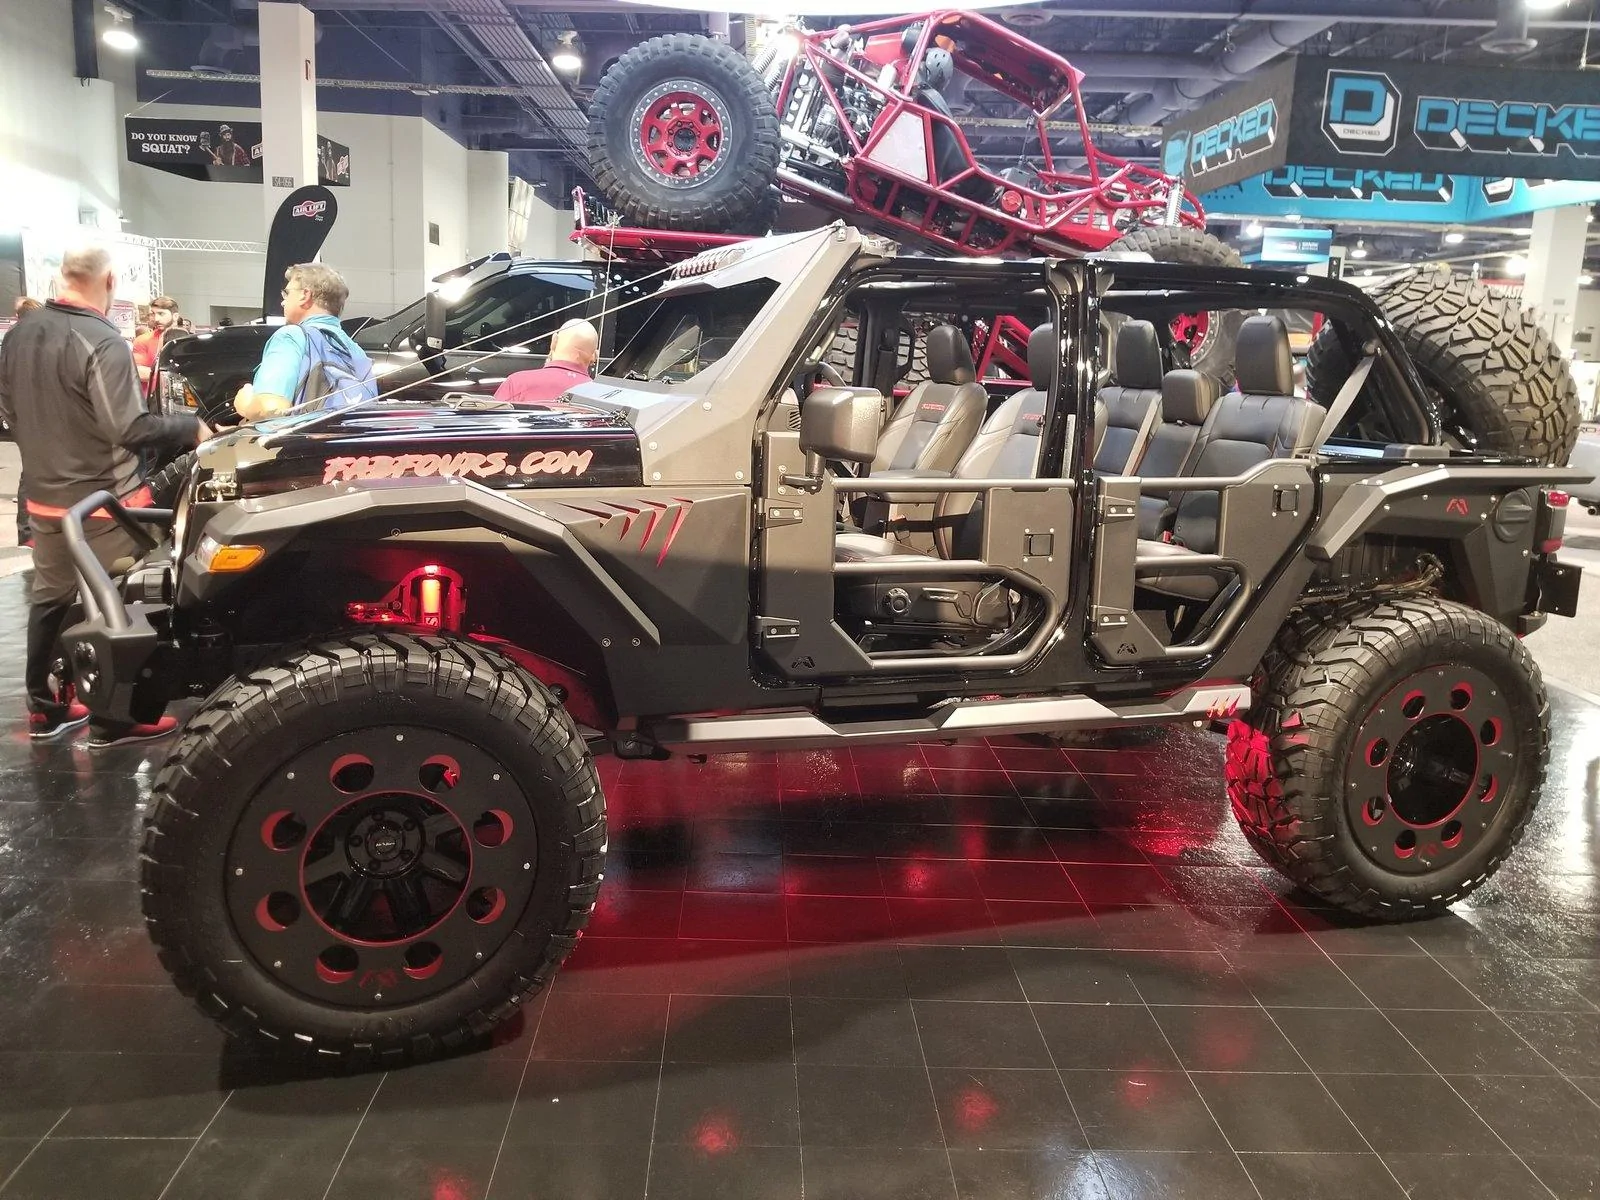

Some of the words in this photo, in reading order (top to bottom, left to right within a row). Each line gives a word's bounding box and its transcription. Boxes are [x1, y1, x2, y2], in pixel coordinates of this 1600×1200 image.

[1191, 102, 1274, 164] DECKED
[1416, 99, 1600, 141] DECKE
[131, 132, 146, 140] DO
[147, 133, 166, 141] YOU
[168, 134, 198, 143] KNOW
[141, 142, 191, 154] SQUAT?
